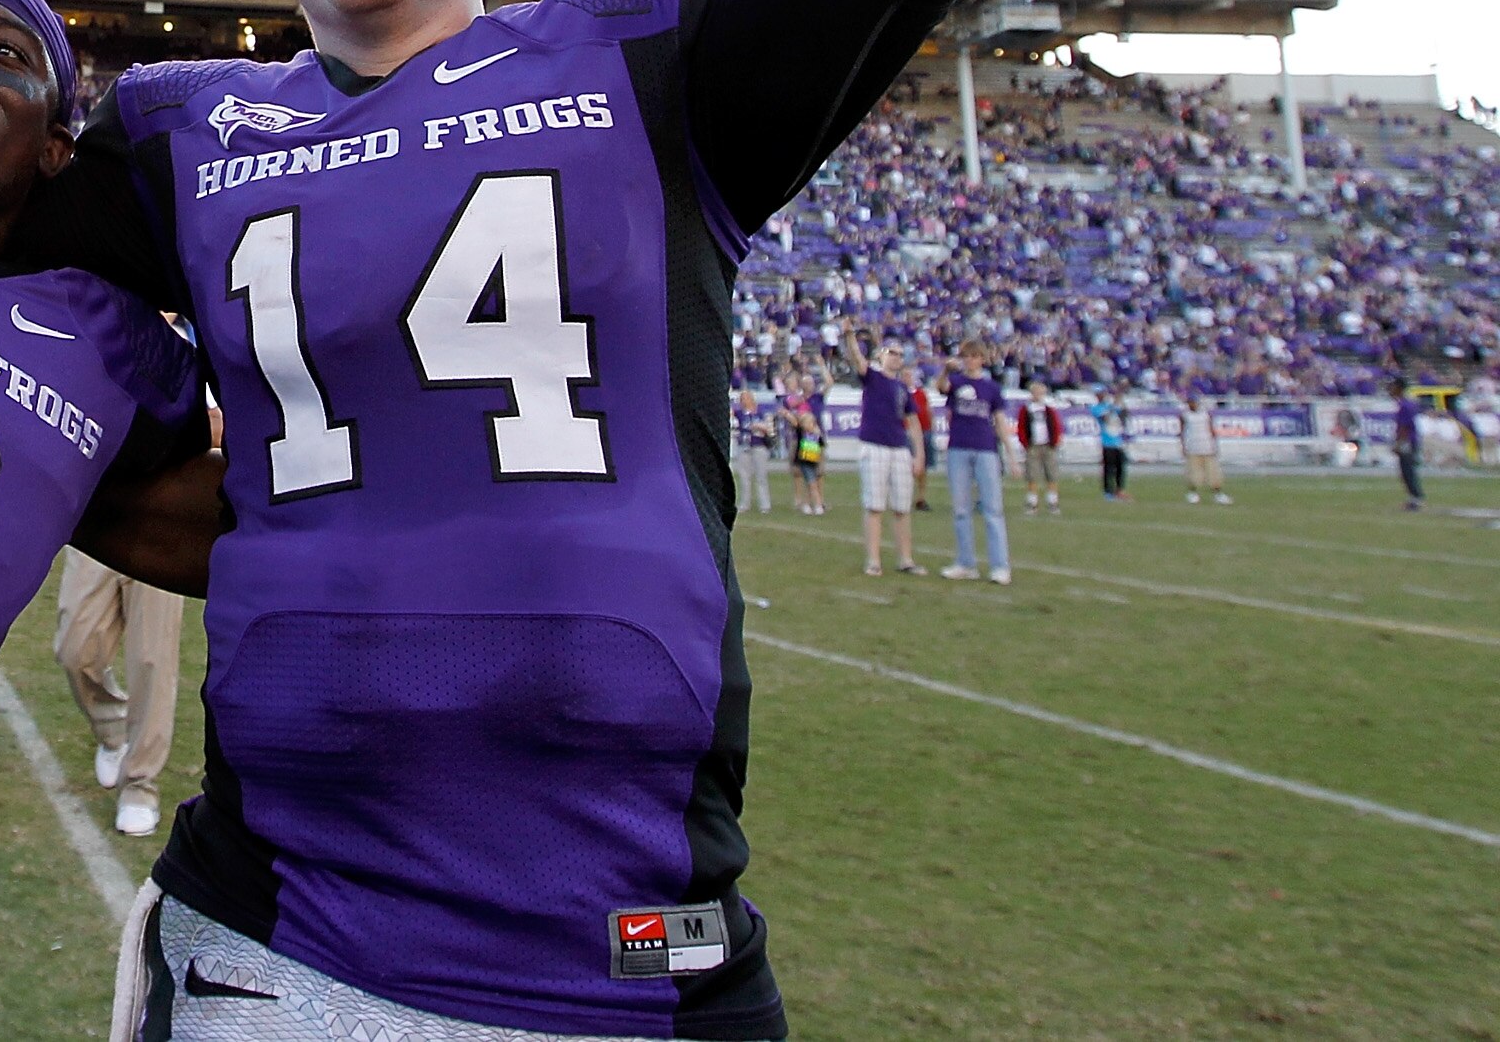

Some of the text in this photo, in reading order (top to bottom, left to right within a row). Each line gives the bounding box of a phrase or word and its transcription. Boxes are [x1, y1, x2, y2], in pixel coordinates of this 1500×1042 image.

[193, 92, 615, 200] HORNED FROGS
[226, 169, 616, 504] 14
[626, 940, 663, 950] TEAM
[683, 918, 705, 940] M
